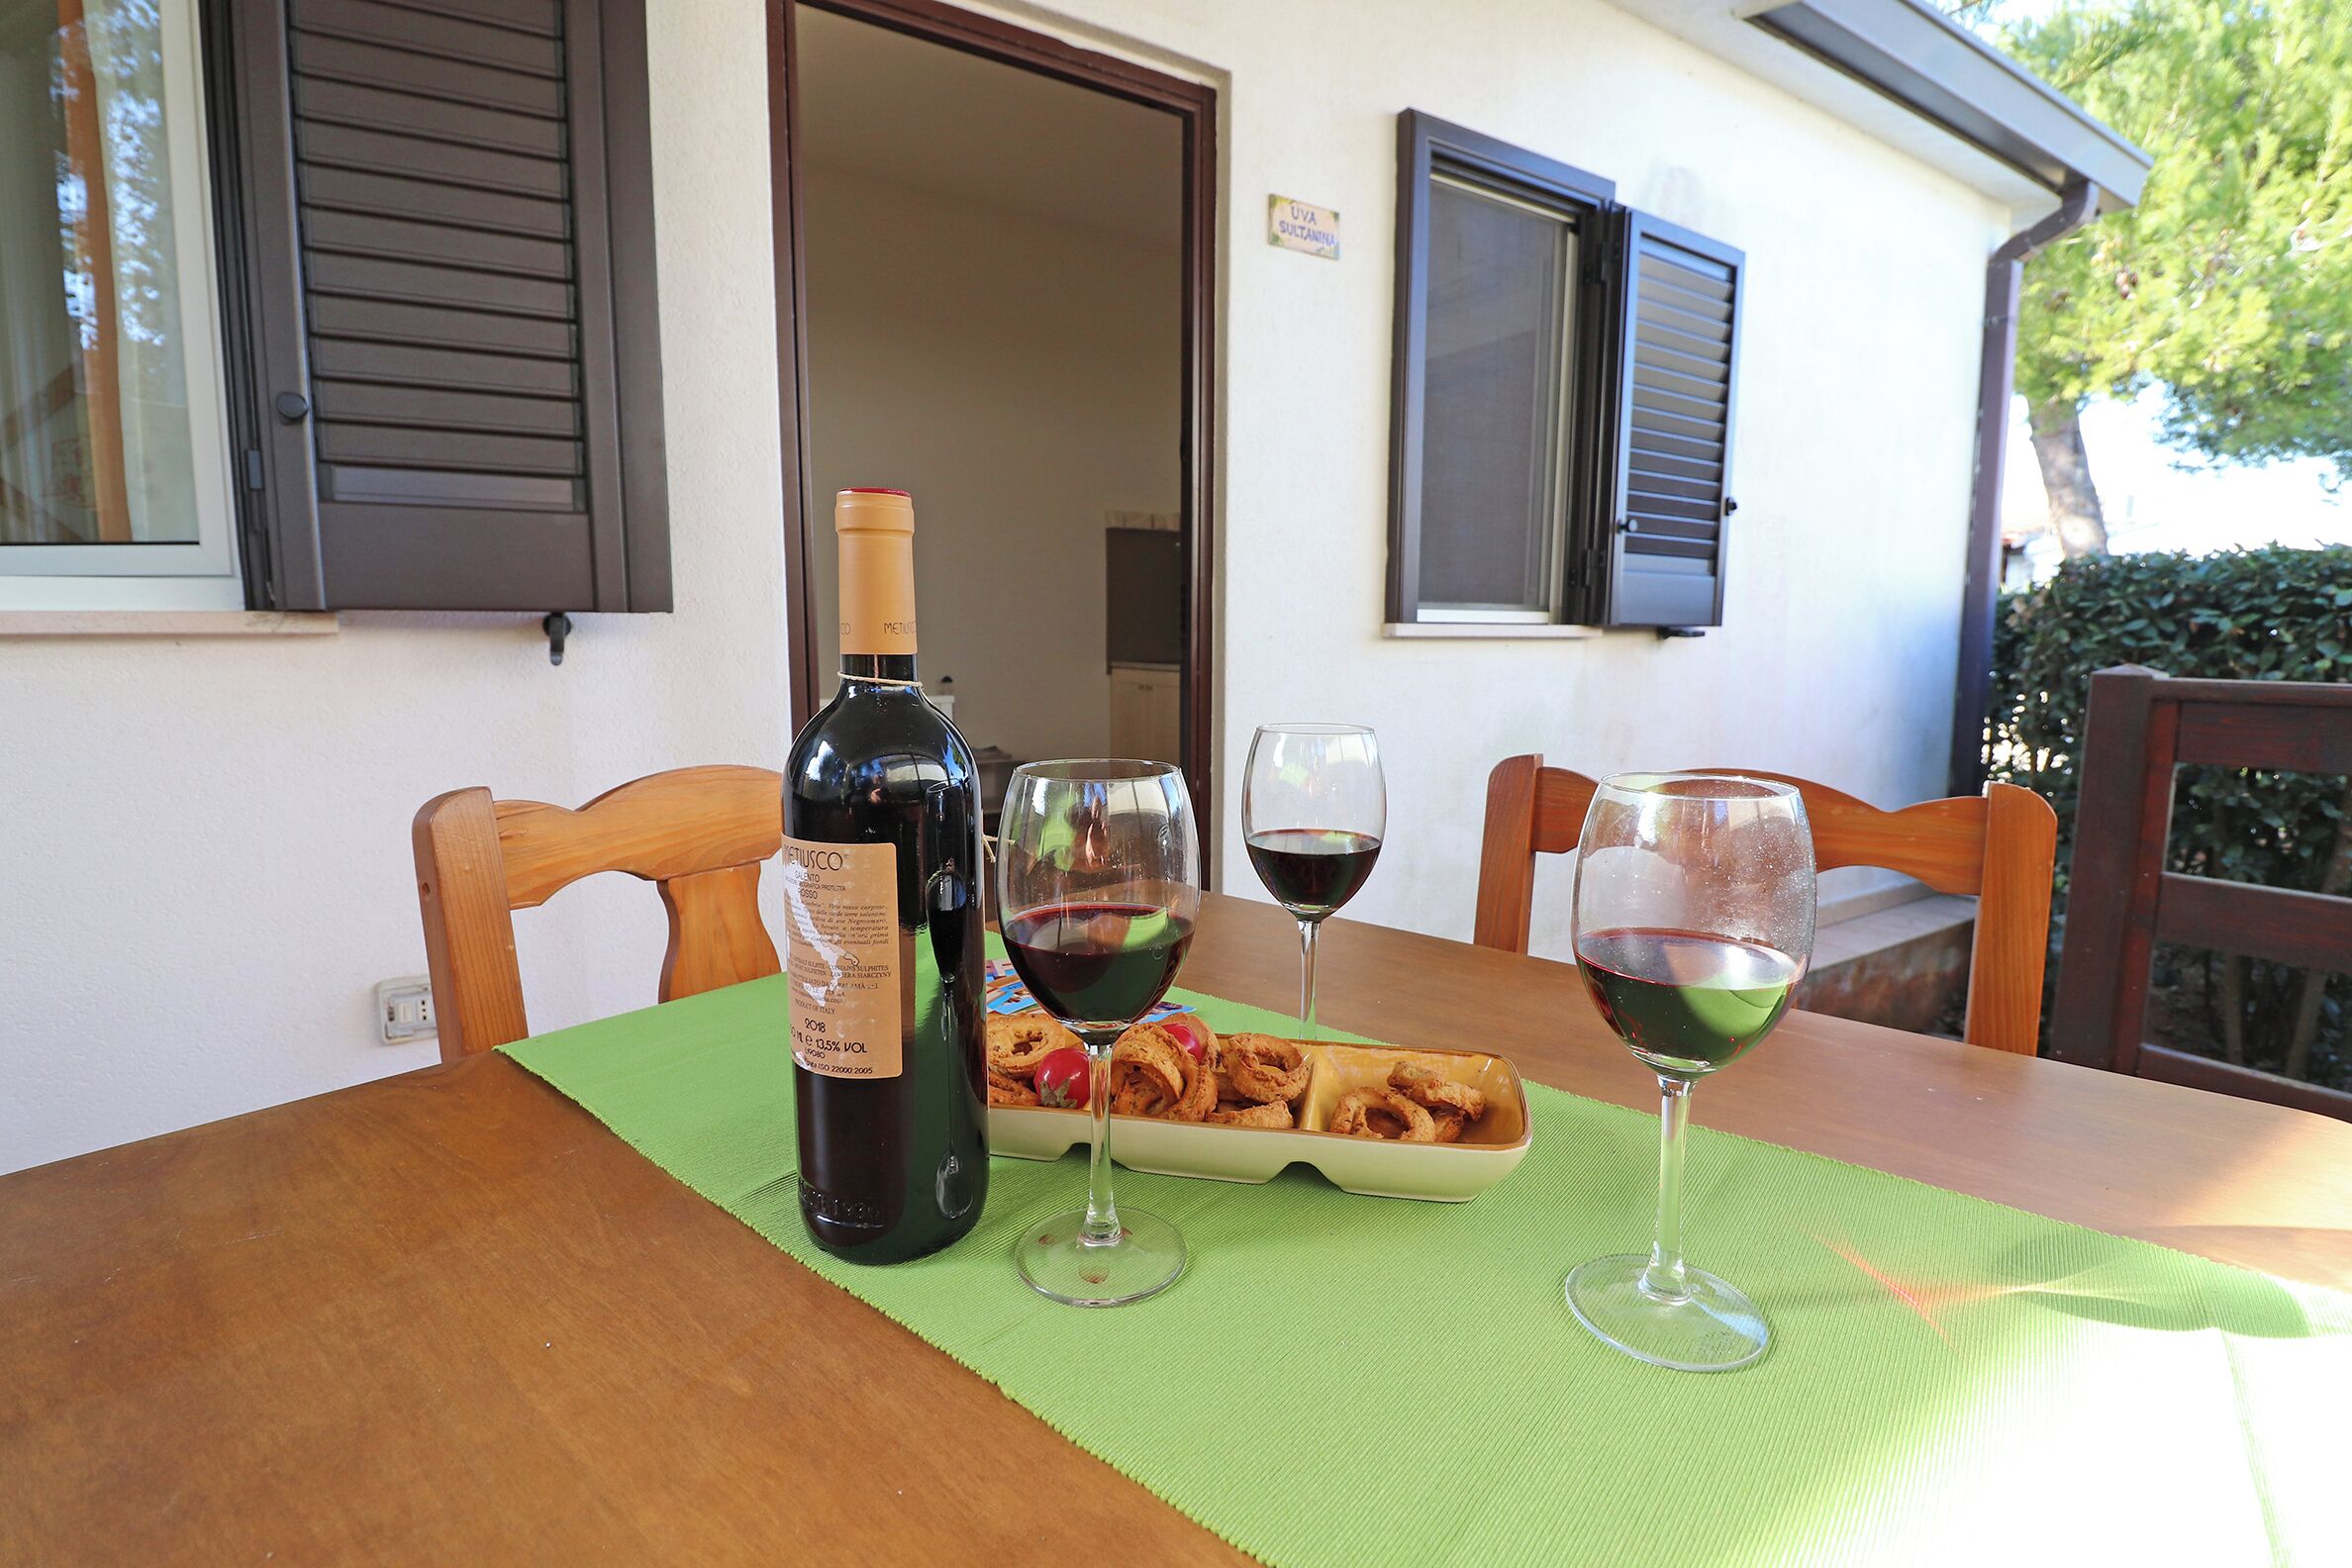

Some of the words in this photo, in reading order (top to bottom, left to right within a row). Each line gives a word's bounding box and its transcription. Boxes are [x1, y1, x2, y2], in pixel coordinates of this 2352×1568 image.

[1291, 205, 1317, 226] UVA
[1278, 220, 1336, 246] SULTANINA
[795, 870, 820, 883] SALENTO
[805, 1018, 826, 1032] 2018
[844, 1042, 868, 1054] VOL
